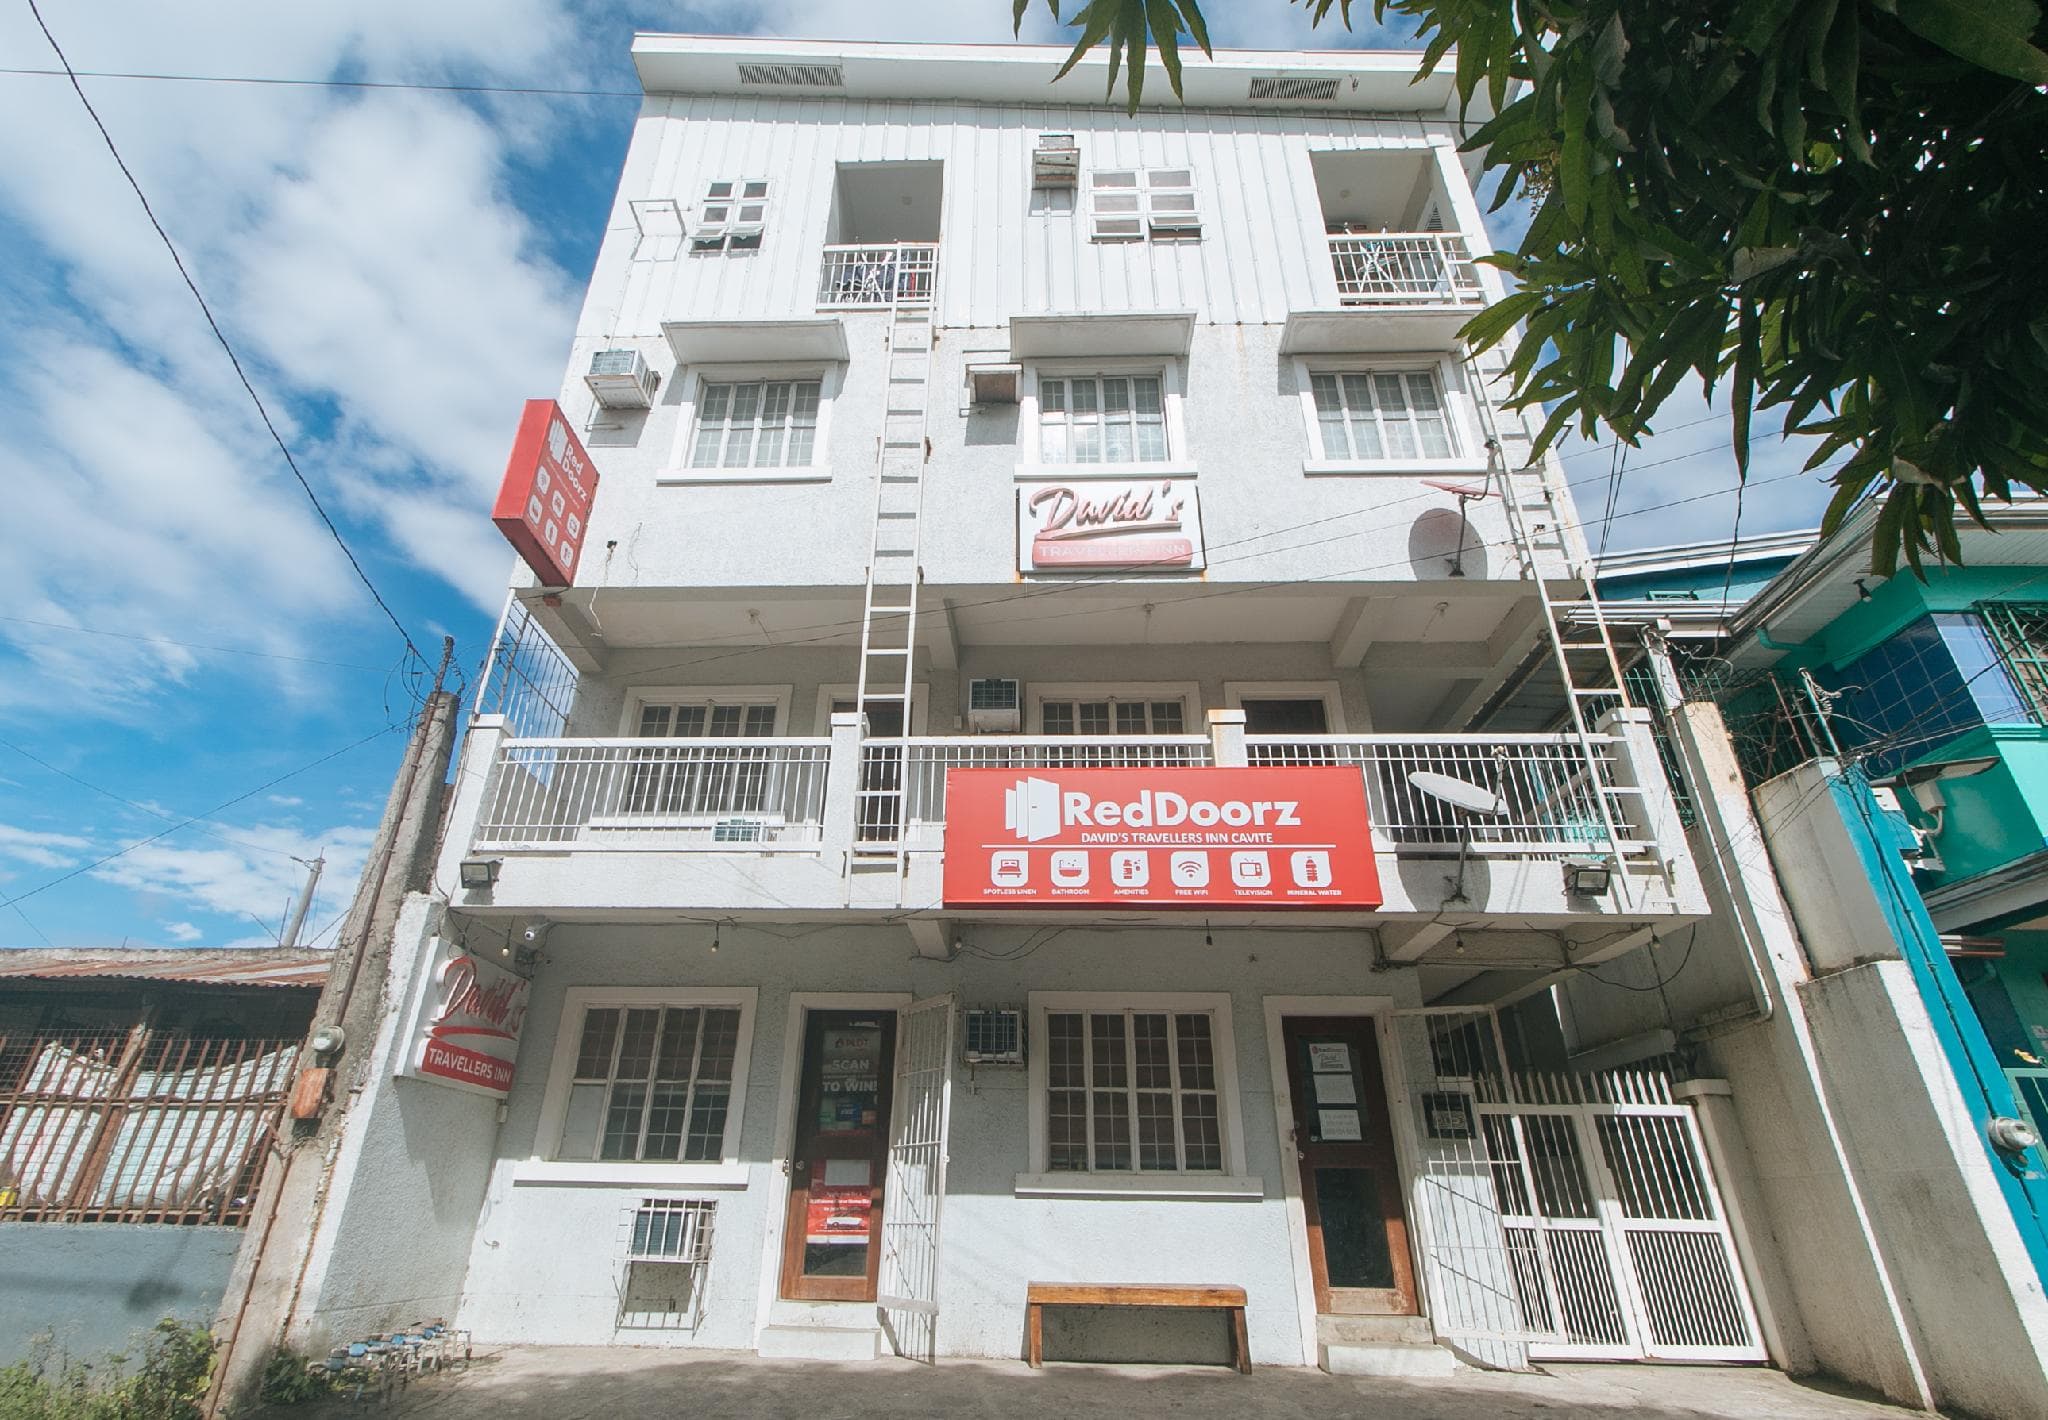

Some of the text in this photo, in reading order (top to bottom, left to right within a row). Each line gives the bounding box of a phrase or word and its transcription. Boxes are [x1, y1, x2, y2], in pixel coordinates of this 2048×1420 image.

[566, 443, 584, 475] Red
[562, 457, 587, 502] Doorz
[1029, 479, 1185, 533] David's
[1063, 789, 1302, 828] RedDoorz
[1081, 832, 1274, 844] DAVID'S TRAVELLERS INN CAVITE
[1051, 888, 1090, 896] BATHROOM
[1113, 888, 1149, 896] AMENITIES
[428, 1048, 513, 1084] TRAVELLERS INN
[832, 1059, 870, 1071] SCAN
[822, 1079, 878, 1092] TO WIN!
